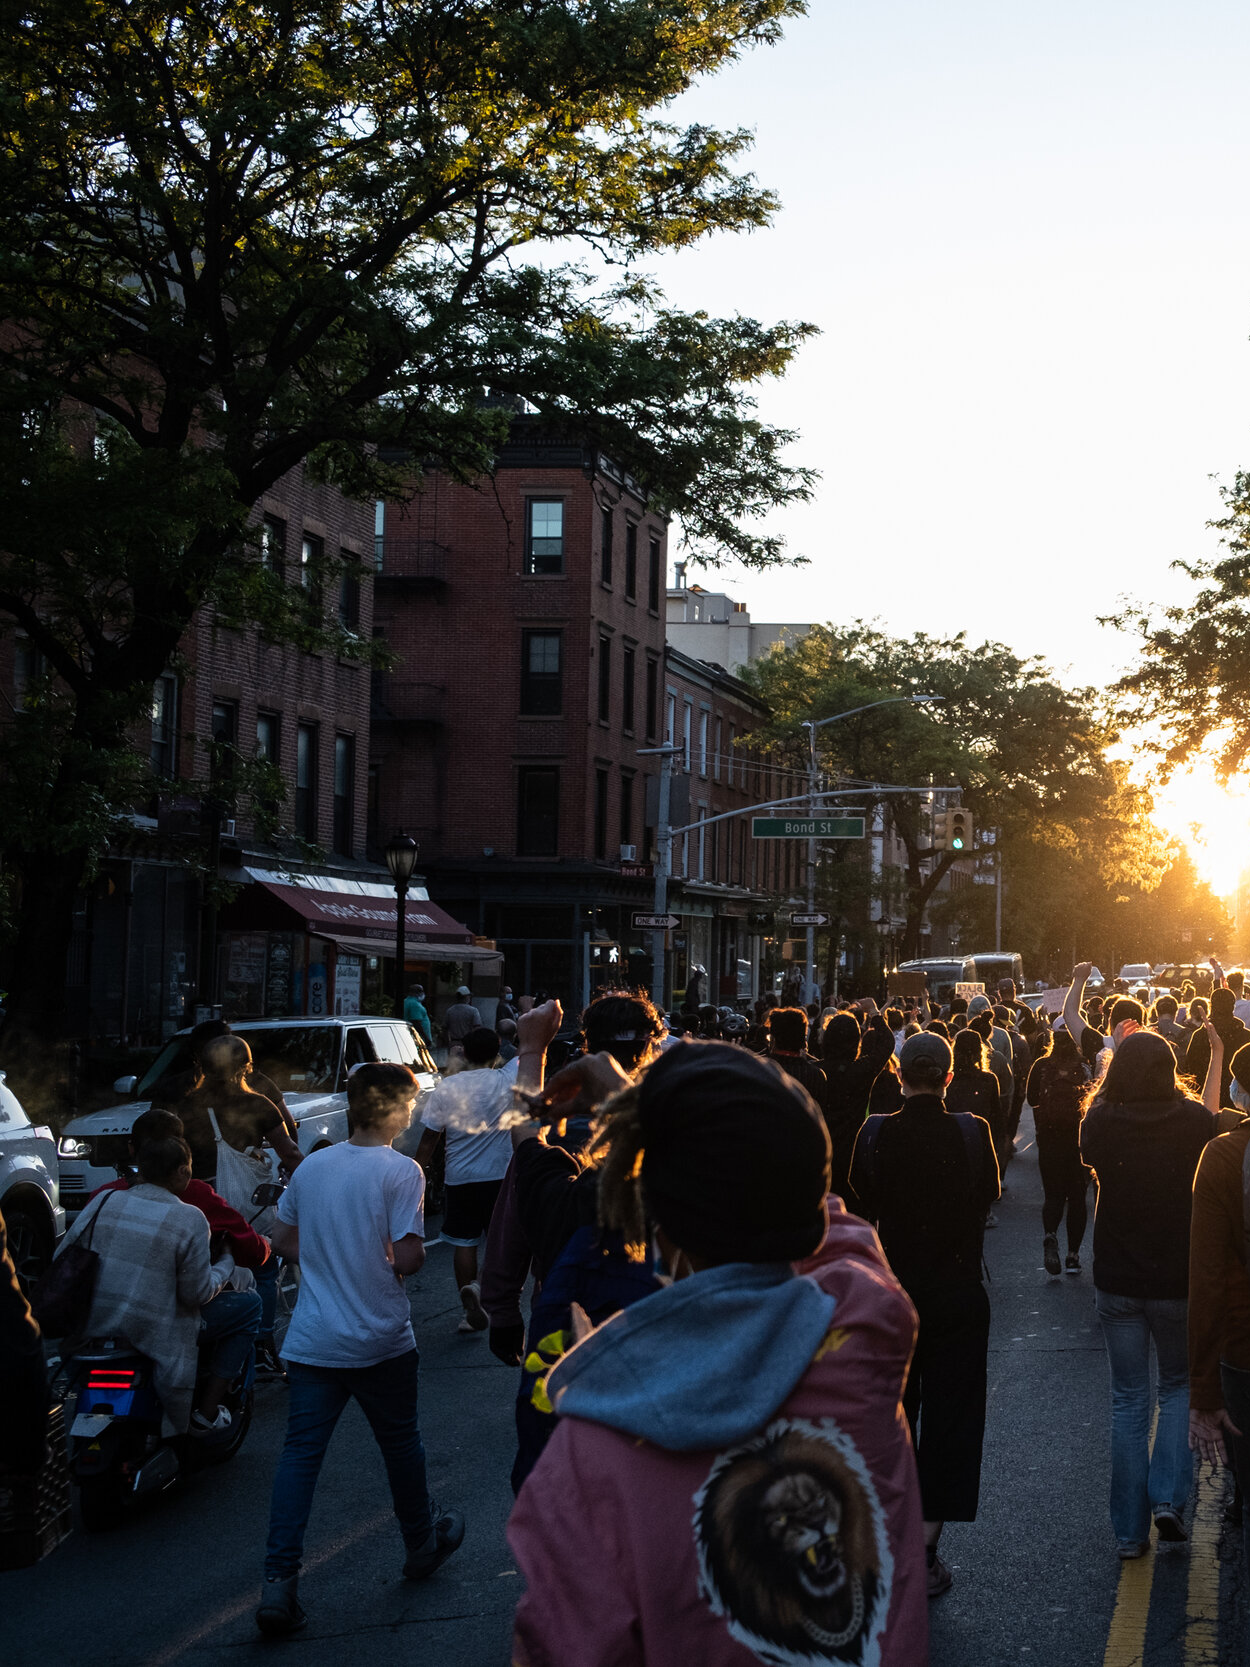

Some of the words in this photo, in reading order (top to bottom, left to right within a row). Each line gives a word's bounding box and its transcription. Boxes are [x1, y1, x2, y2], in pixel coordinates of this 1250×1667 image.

[785, 822, 816, 833] Bond
[820, 822, 832, 833] St
[637, 917, 651, 925] ONE
[312, 982, 322, 1014] core
